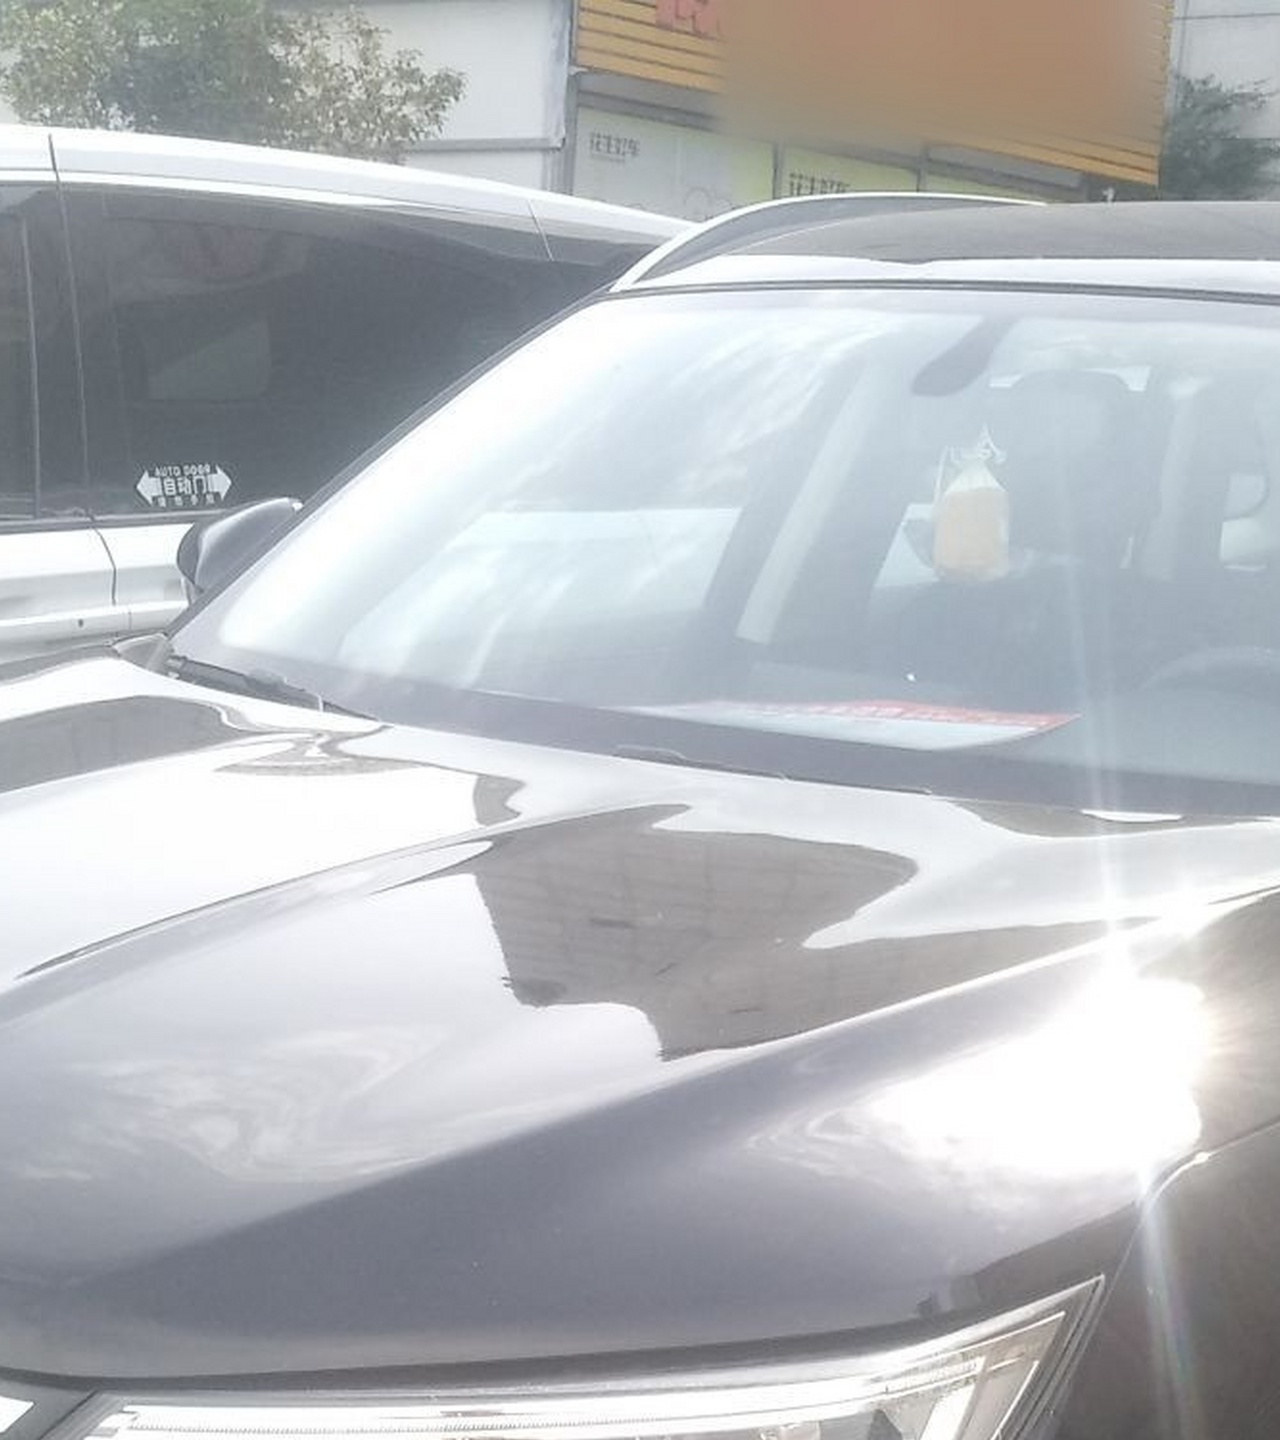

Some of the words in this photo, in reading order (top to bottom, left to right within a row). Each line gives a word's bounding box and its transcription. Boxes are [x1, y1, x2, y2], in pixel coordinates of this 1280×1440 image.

[155, 465, 181, 476] AUTO
[164, 475, 207, 496] 自动门
